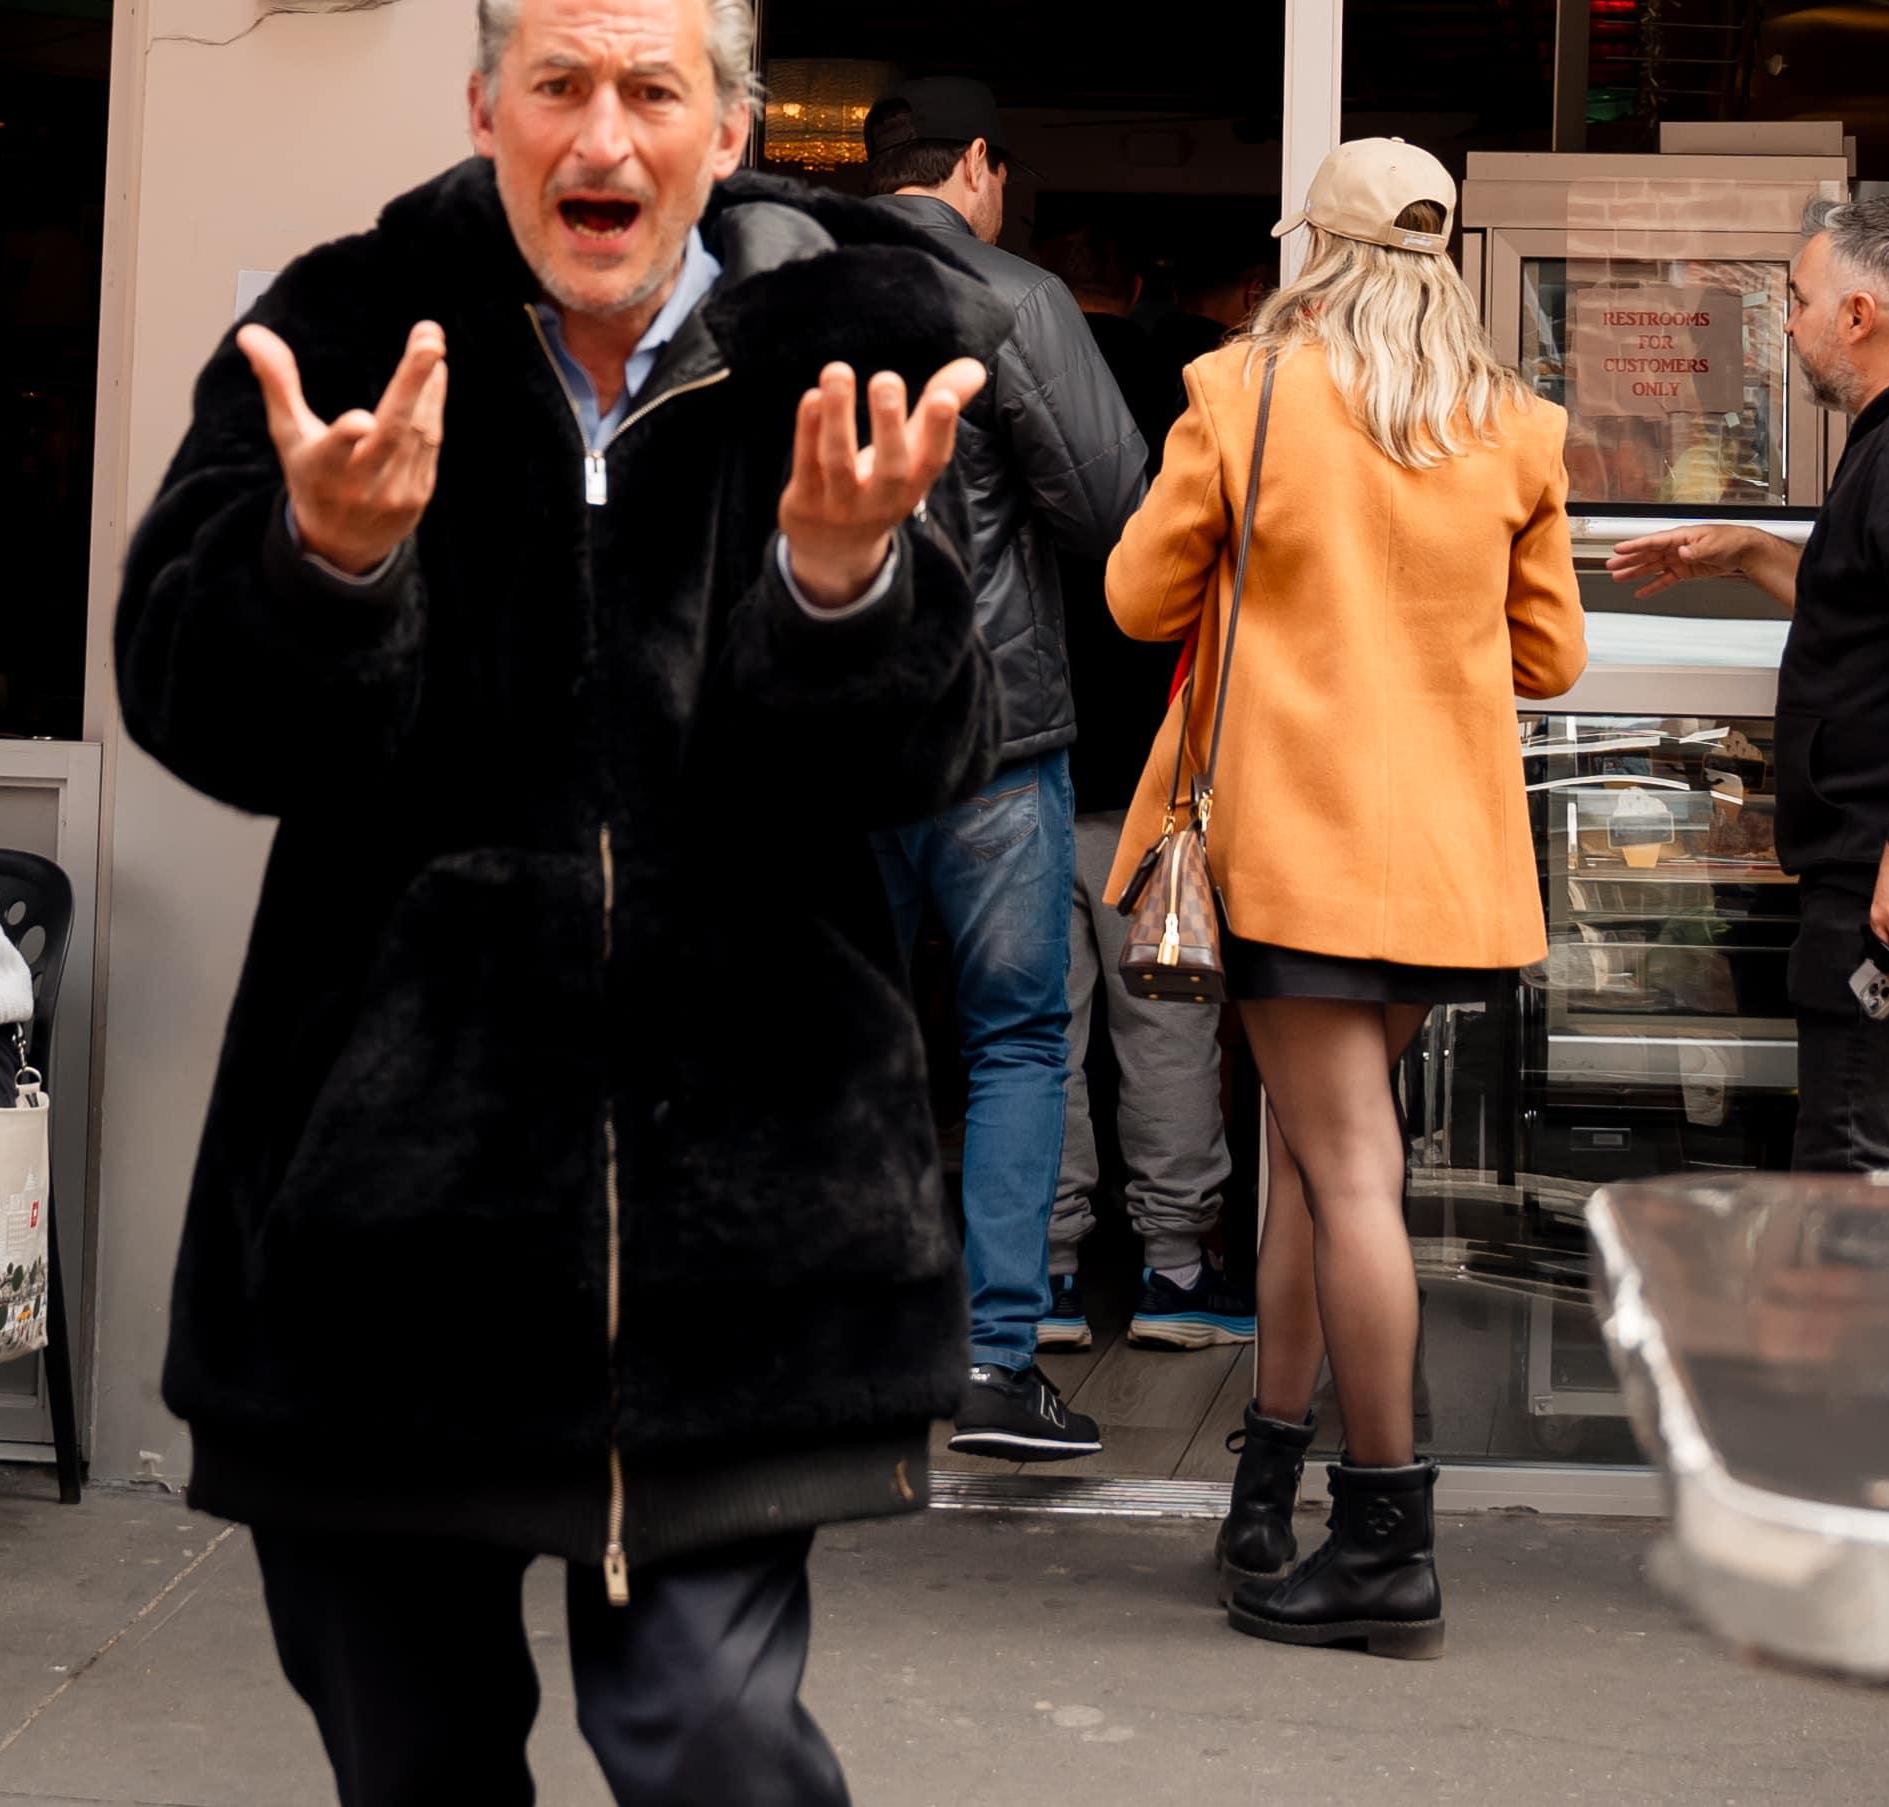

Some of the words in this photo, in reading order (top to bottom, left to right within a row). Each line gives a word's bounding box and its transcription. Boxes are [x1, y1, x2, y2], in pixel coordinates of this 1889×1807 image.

[1603, 311, 1710, 327] RESTROOMS
[1638, 335, 1674, 350] FOR
[1603, 358, 1710, 373] CUSTOMERS
[1632, 382, 1680, 397] ONLY
